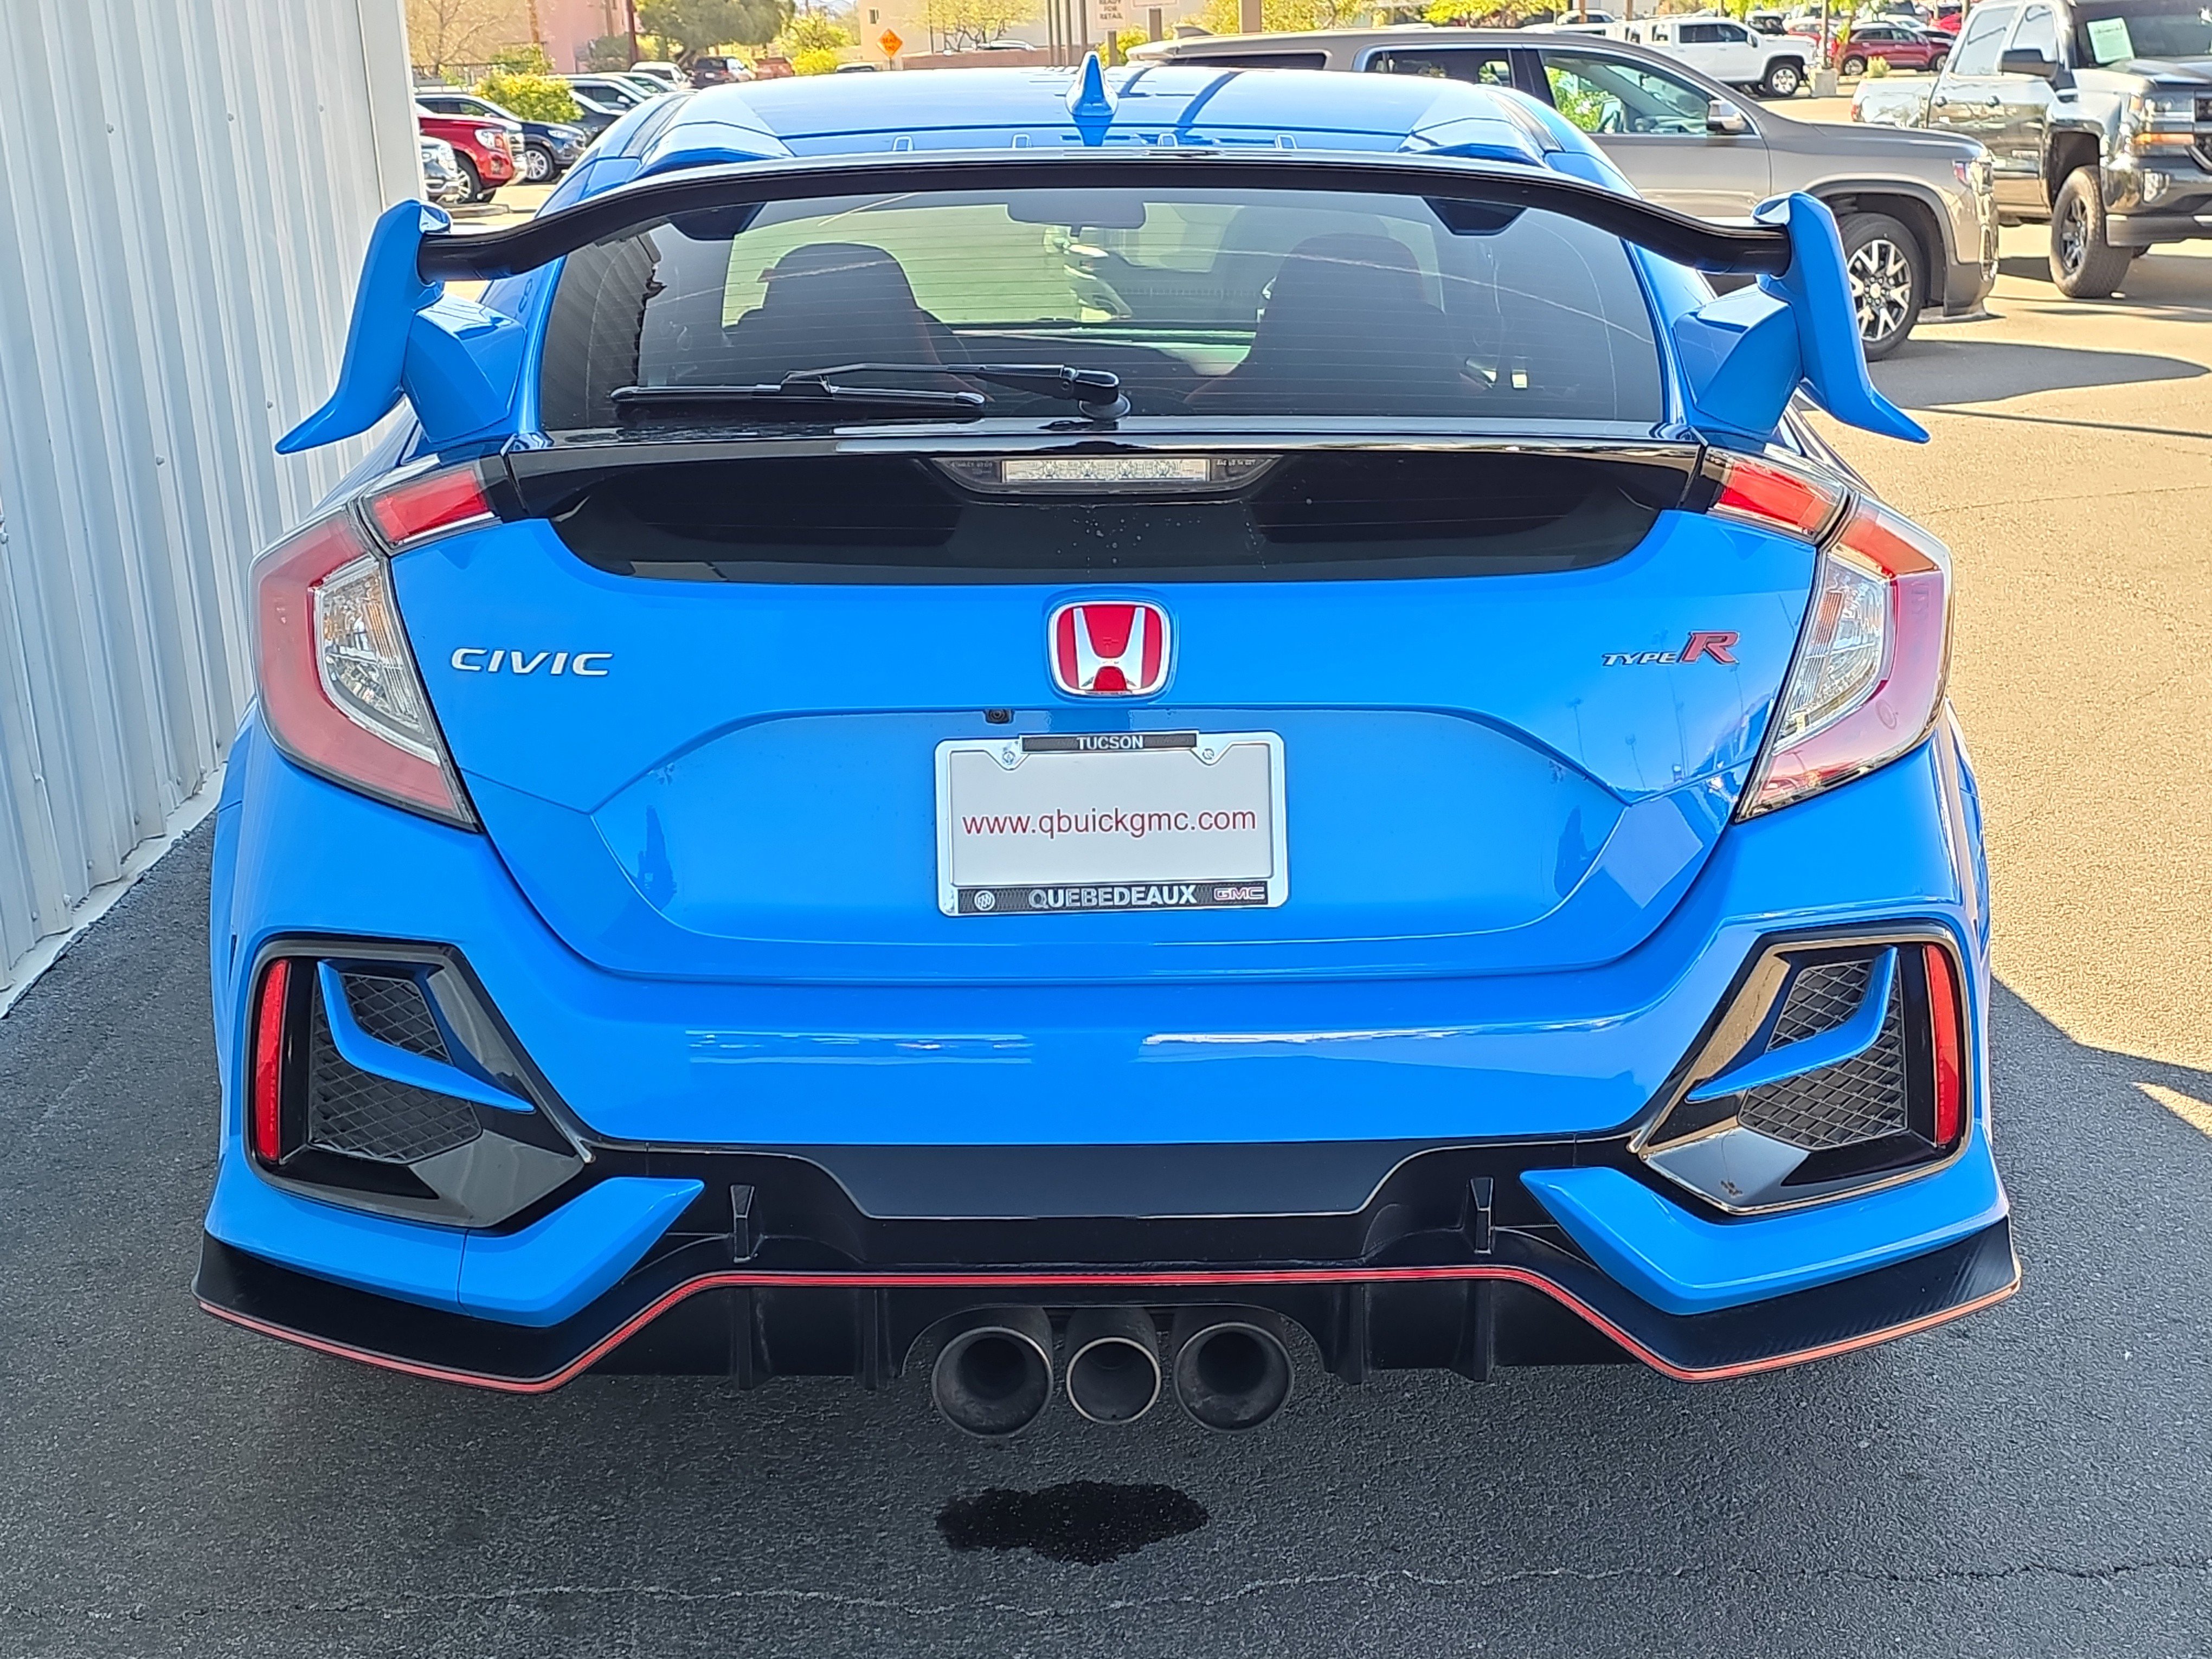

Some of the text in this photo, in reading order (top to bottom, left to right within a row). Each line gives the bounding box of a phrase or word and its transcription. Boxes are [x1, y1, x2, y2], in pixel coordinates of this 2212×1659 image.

[451, 647, 613, 676] CIVIC
[1602, 629, 1740, 666] TYPE R
[1076, 735, 1144, 750] TUCSON
[961, 807, 1256, 839] www.qbuickgmc.com
[1029, 884, 1265, 909] QUEBEDEAUX GMC
